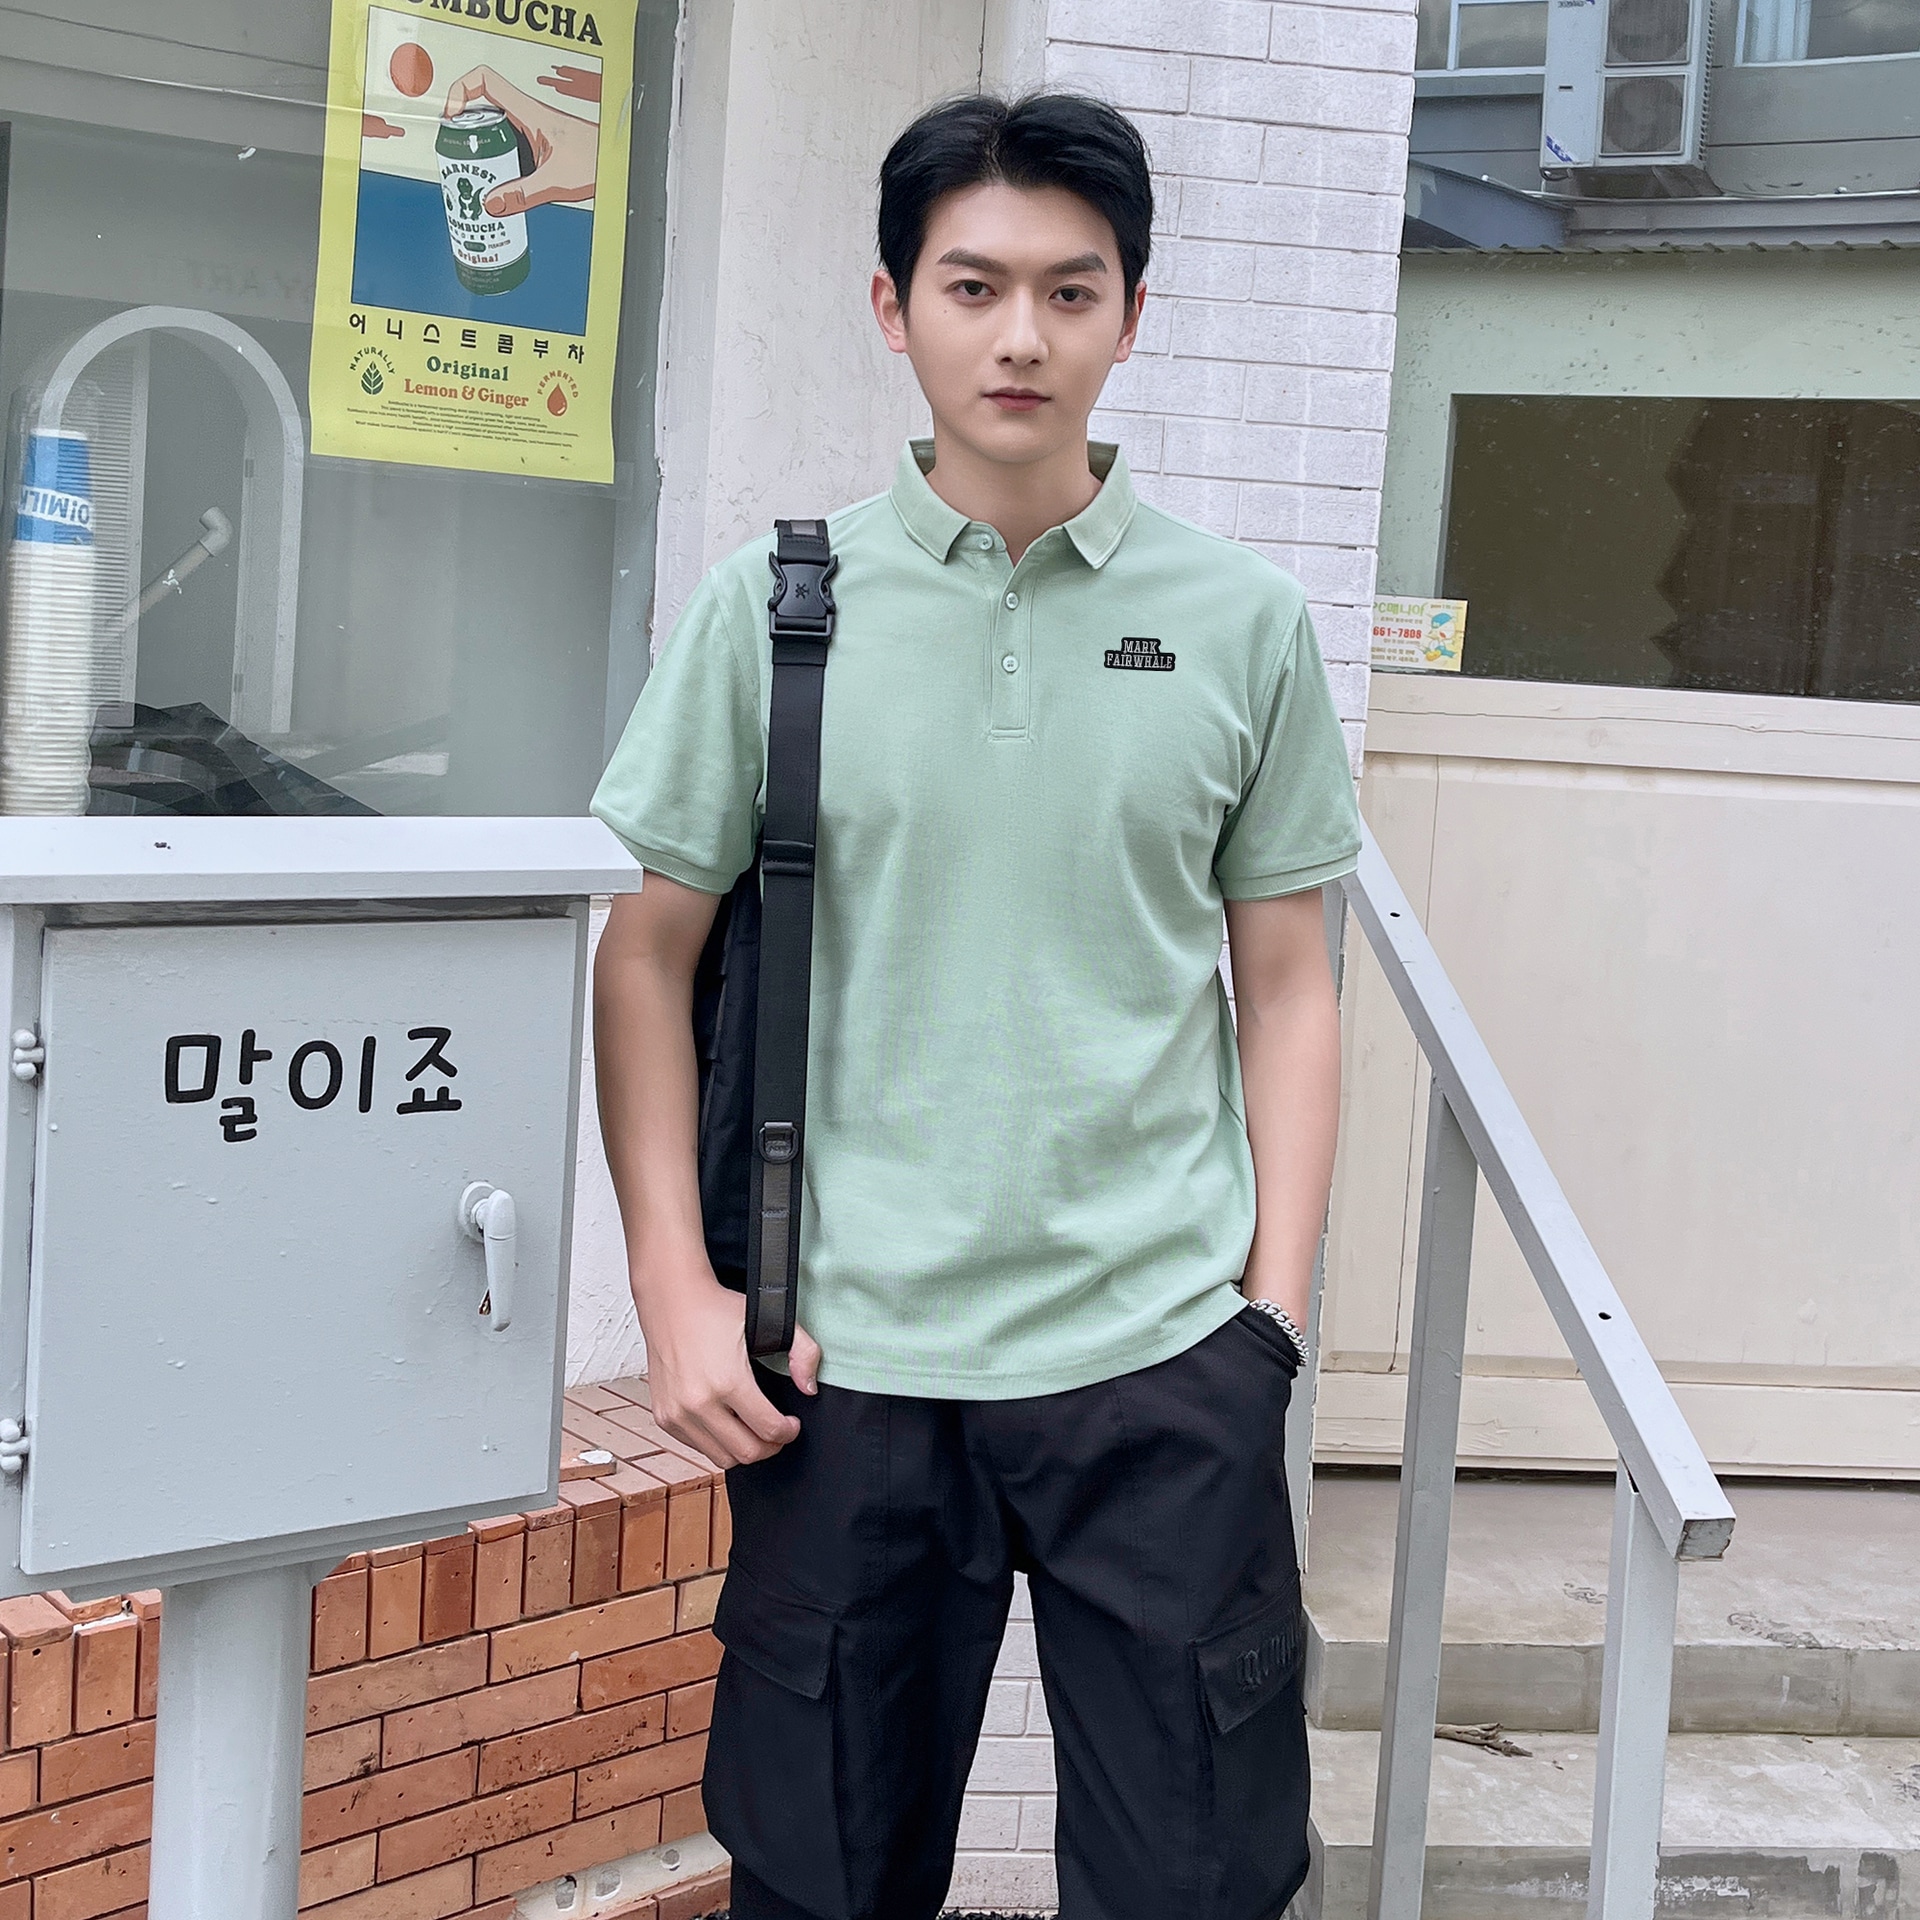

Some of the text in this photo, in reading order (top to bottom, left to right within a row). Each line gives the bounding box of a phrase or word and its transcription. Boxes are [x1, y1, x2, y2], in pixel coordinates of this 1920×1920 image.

[457, 249, 499, 264] Original
[349, 346, 395, 375] NATURALLY
[426, 355, 509, 382] Original
[404, 378, 529, 409] Lemon & Ginger
[537, 369, 579, 398] FERMENTED
[1106, 653, 1173, 669] FAIRWHALE
[1123, 640, 1158, 654] MARK
[165, 1027, 462, 1142] 말이죠
